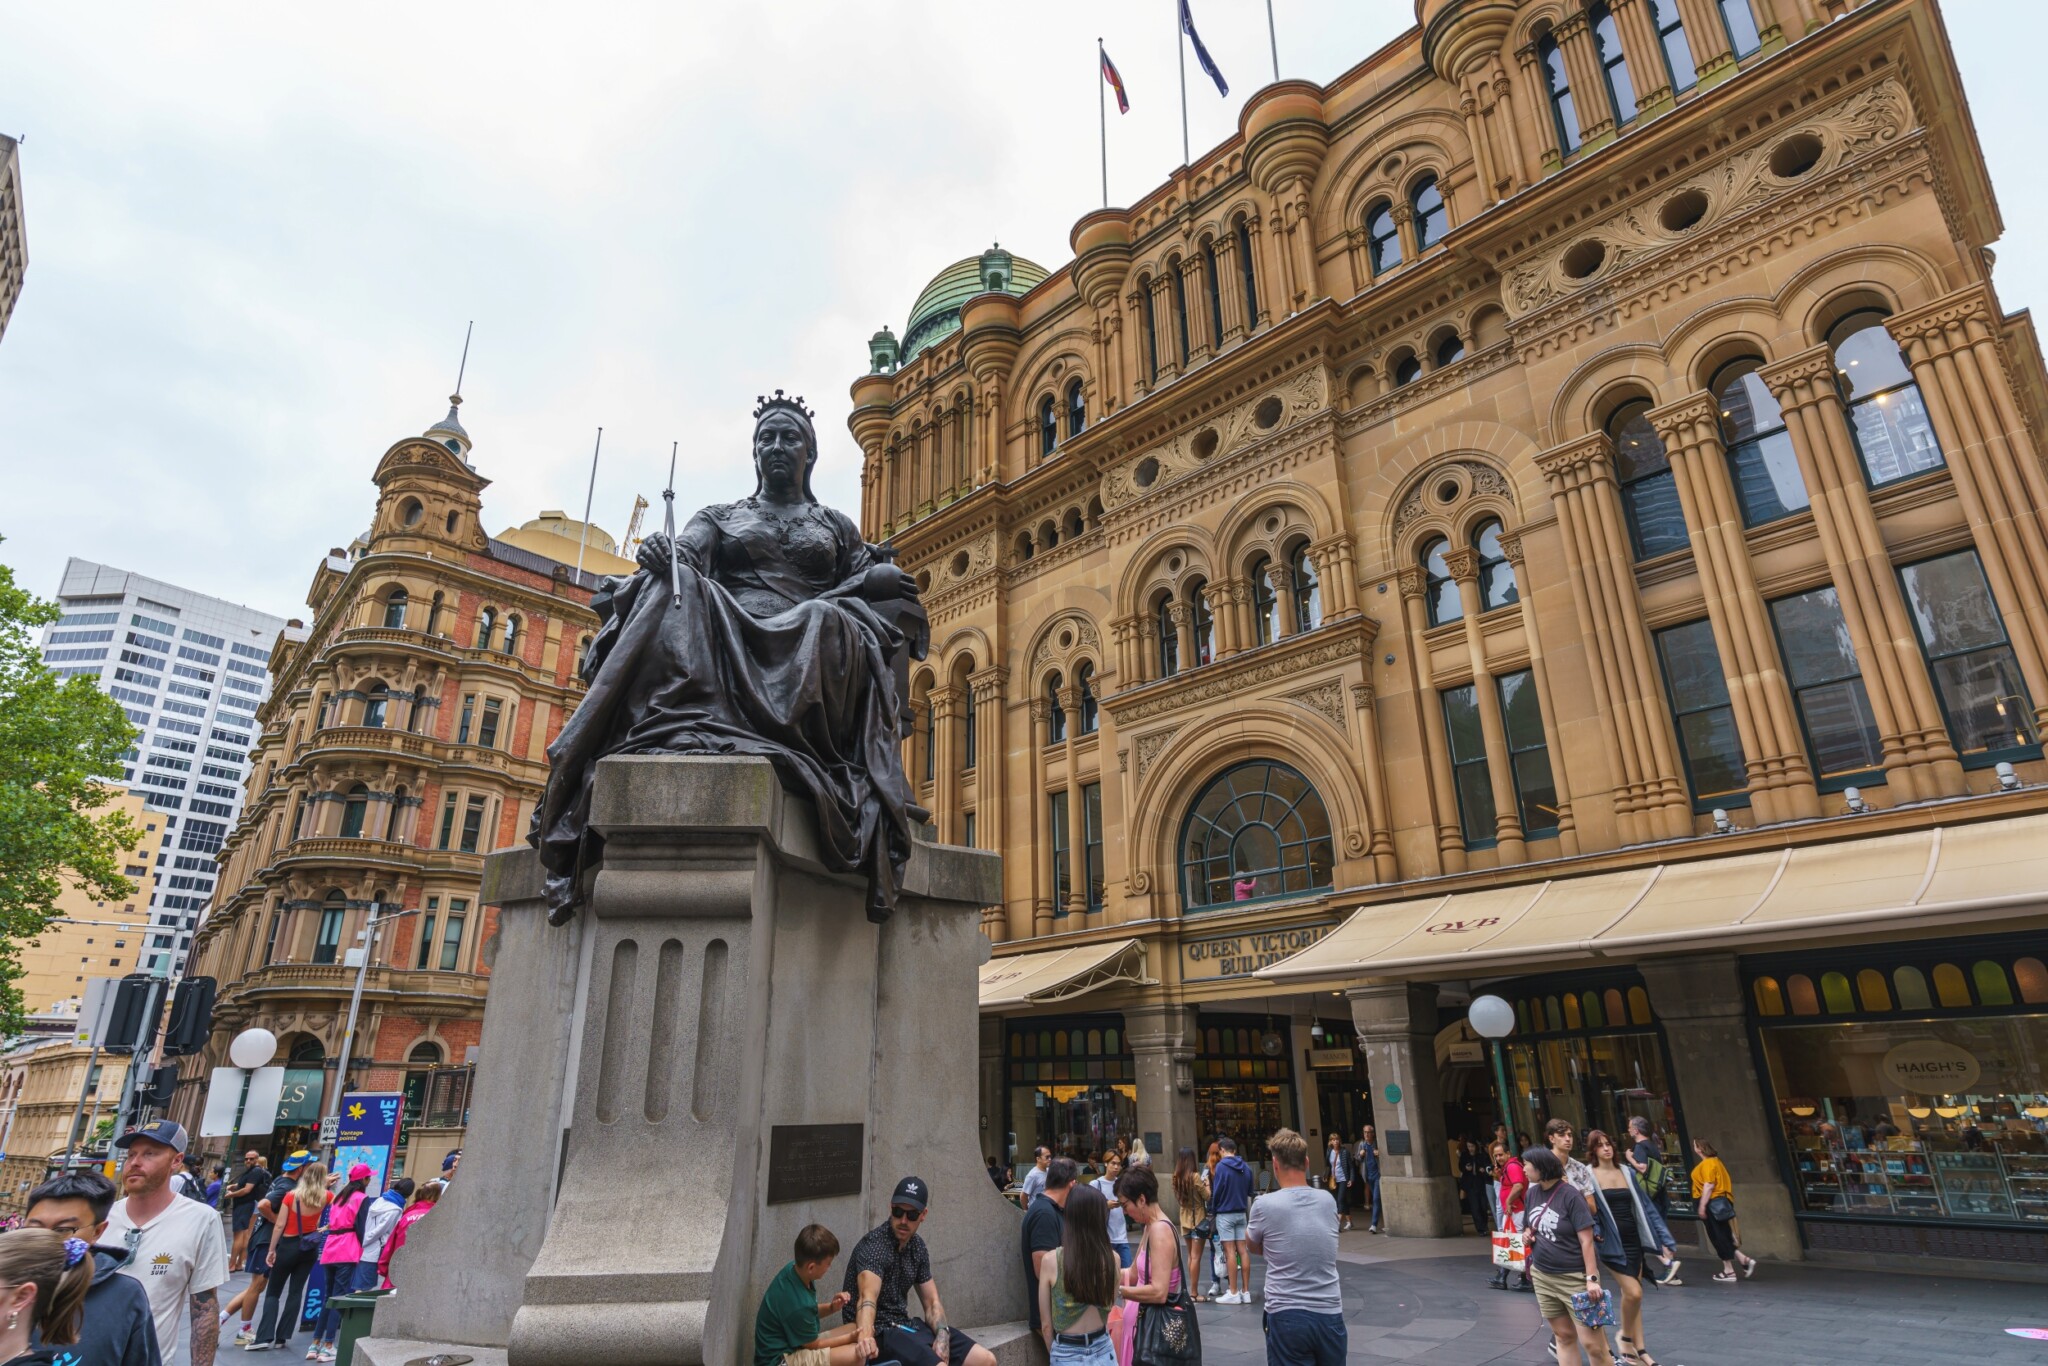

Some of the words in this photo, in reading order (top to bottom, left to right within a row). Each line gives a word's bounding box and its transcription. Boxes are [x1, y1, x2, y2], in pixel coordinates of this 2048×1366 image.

[1426, 917, 1500, 935] QVB
[1188, 938, 1242, 961] QUEEN
[1249, 927, 1330, 952] VICTORIA
[1896, 1061, 1967, 1073] HAIGH'S
[324, 1118, 340, 1126] ONE
[380, 1099, 398, 1126] NYE
[400, 1079, 416, 1144] PEARLS
